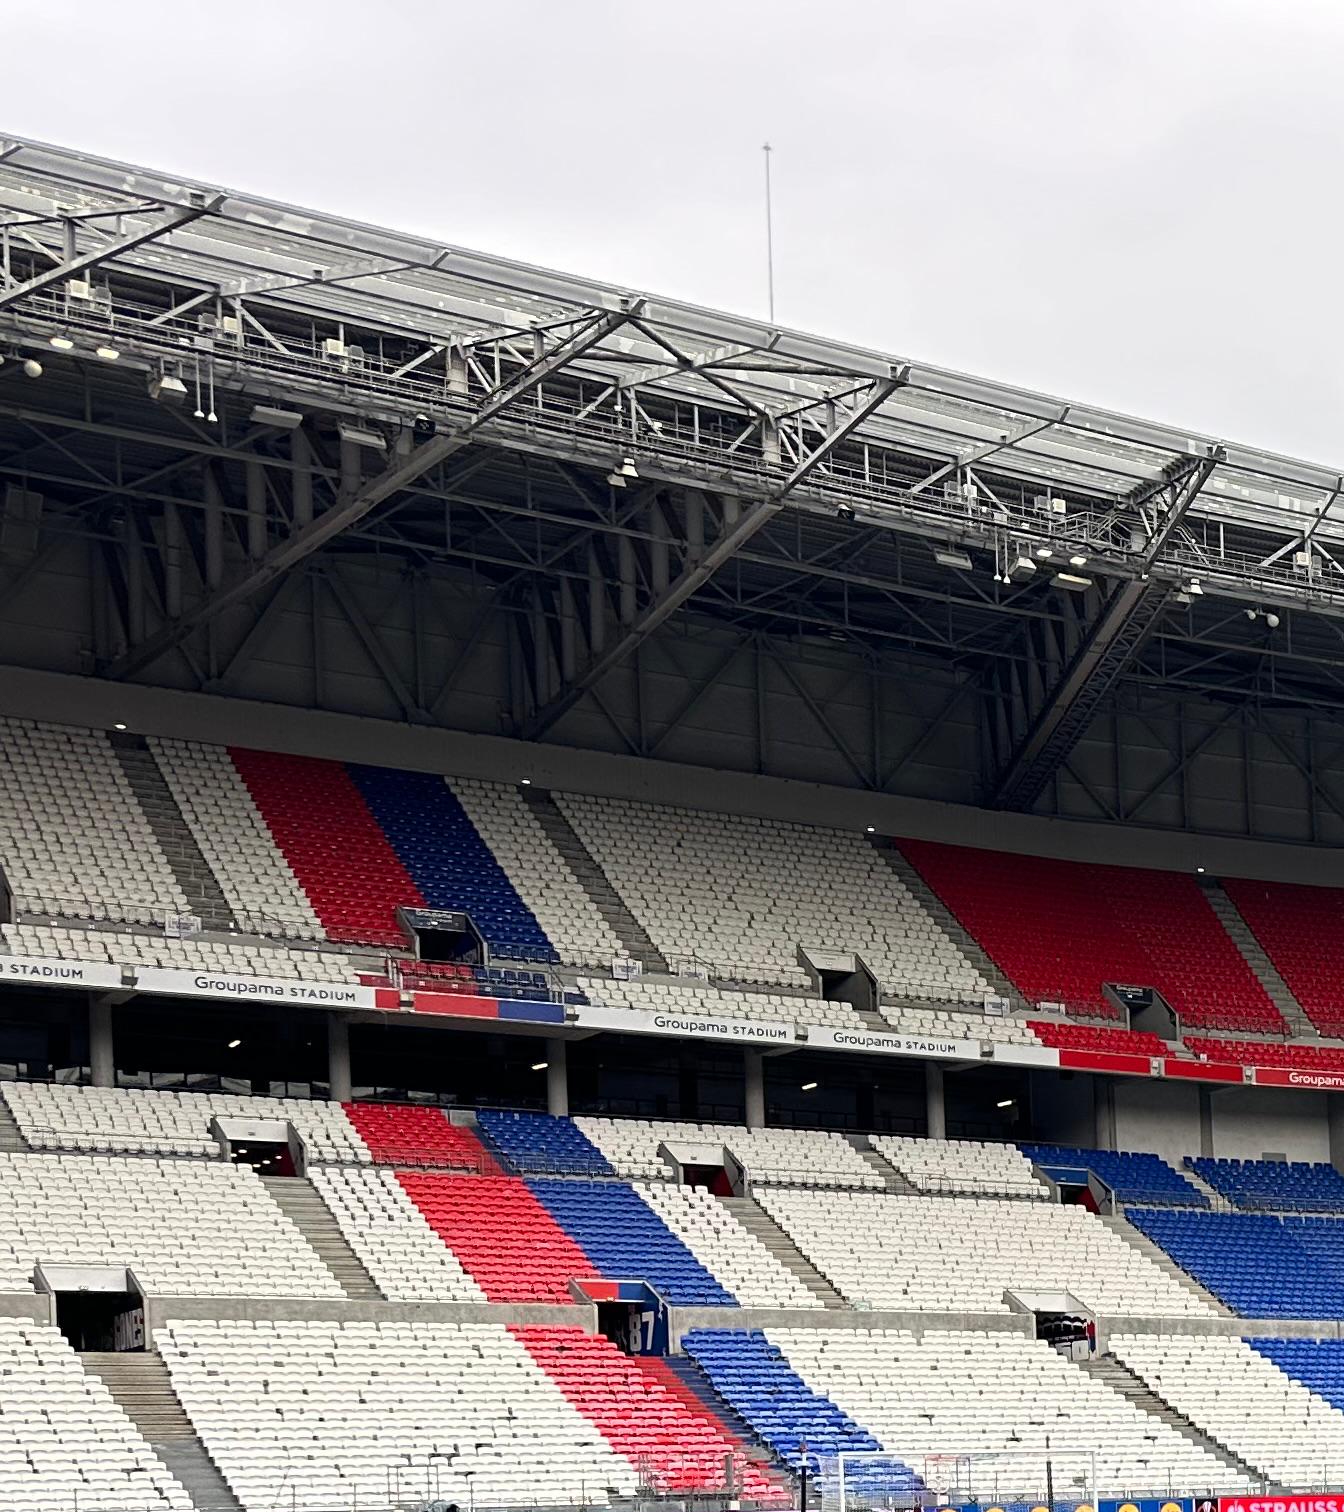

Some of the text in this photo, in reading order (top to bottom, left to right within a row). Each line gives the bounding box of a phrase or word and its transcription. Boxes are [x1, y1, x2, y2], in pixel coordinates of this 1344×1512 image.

[10, 963, 84, 980] STADIUM
[194, 976, 357, 1003] Groupama STADIUM
[654, 1015, 787, 1039] Groupama STADIUM
[833, 1031, 957, 1054] Groupama STADIUM
[629, 1310, 655, 1352] 87
